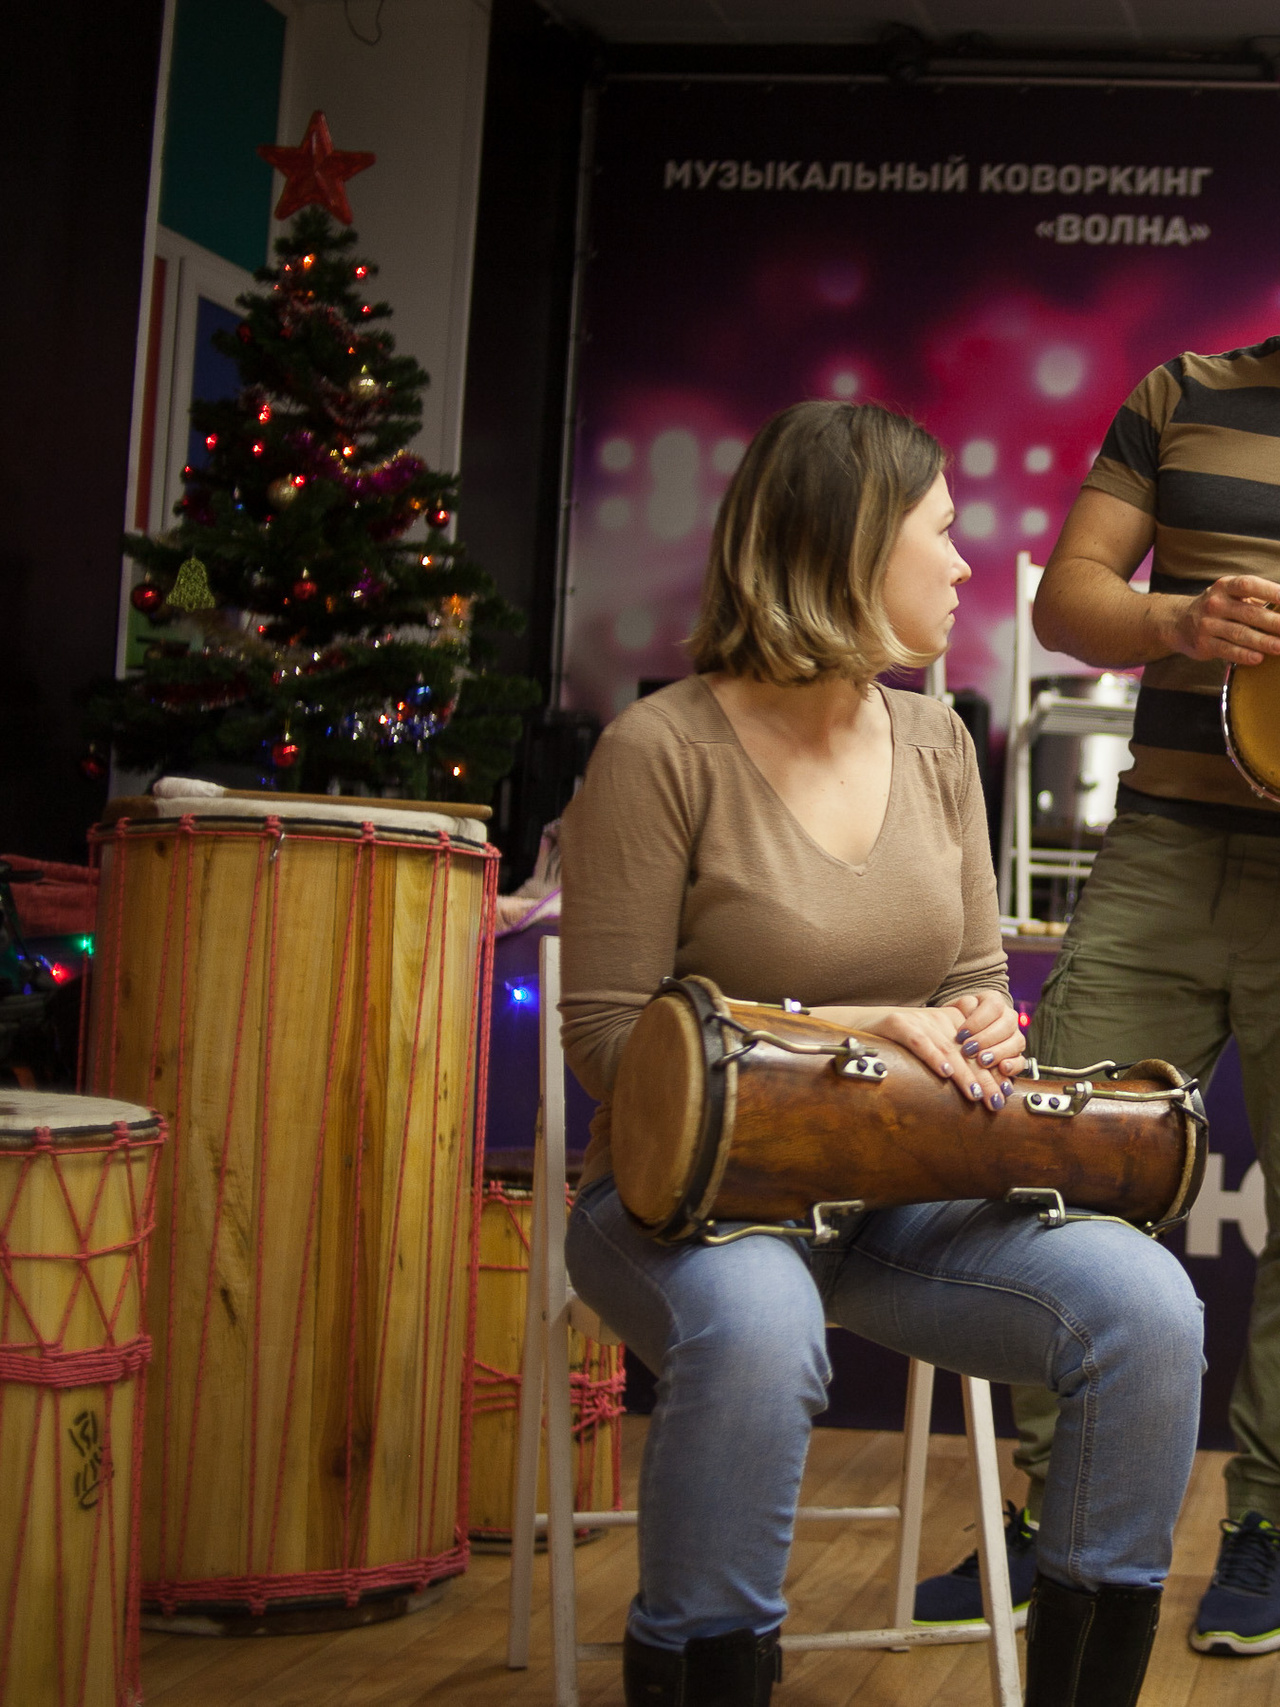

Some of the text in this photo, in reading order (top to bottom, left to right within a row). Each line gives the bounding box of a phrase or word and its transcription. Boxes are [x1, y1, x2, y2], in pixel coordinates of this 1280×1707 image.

[664, 156, 1212, 197] МУЗЫКАЛЬНЫЙ КОВОРКИНГ
[1036, 213, 1211, 247] «ВОЛНА»
